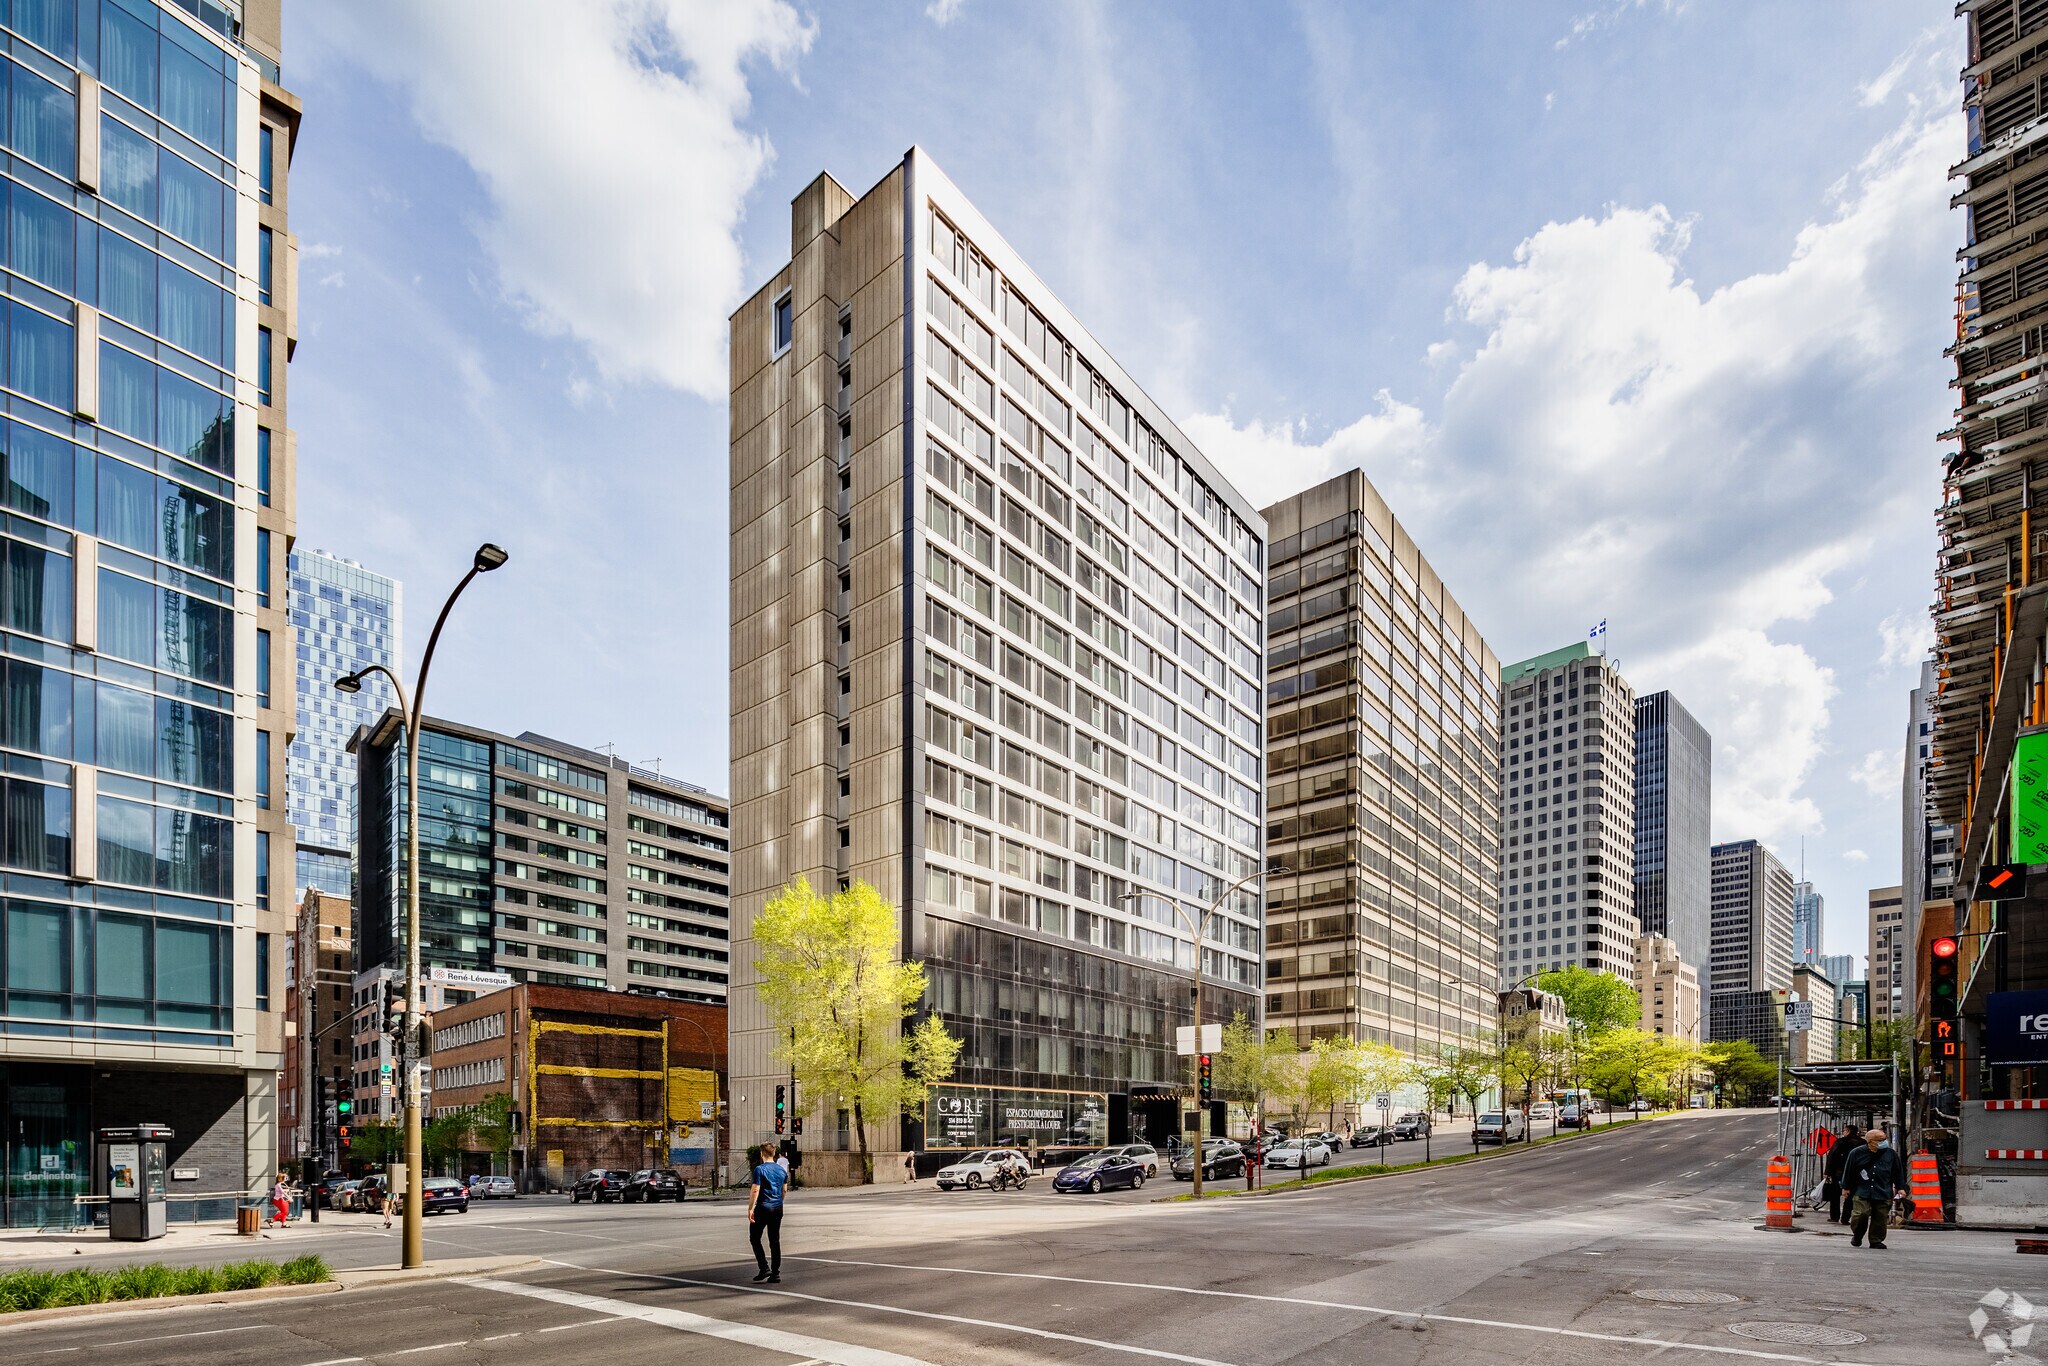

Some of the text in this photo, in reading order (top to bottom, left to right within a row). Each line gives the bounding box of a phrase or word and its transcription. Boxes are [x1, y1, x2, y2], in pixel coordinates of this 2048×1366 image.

[447, 972, 507, 985] René-Lévesque
[2020, 1014, 2048, 1032] re
[1377, 1098, 1388, 1107] 50
[1006, 1108, 1063, 1119] ESPACES COMMERCIAUX
[1045, 1121, 1060, 1130] LOUER
